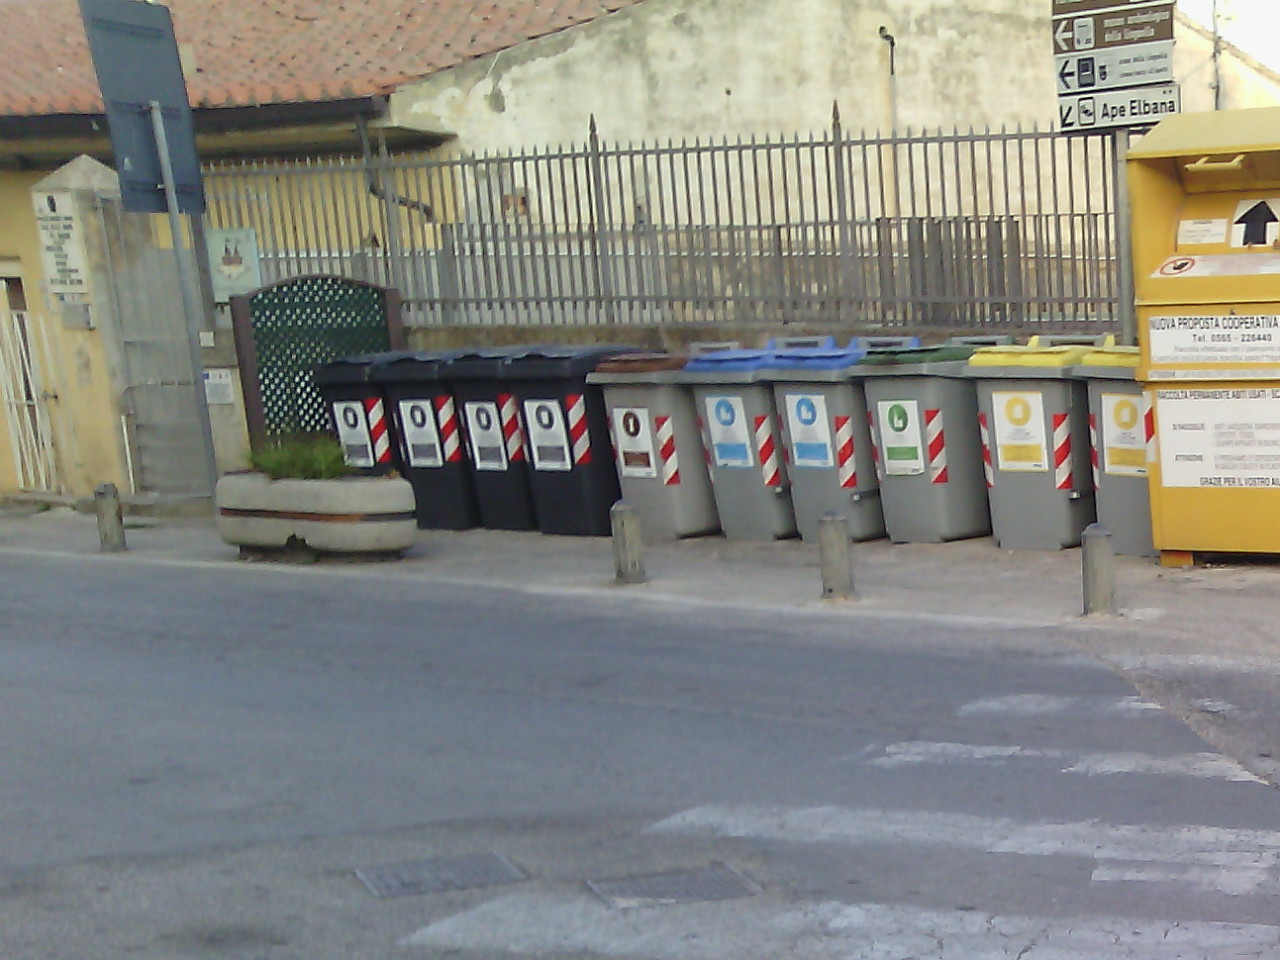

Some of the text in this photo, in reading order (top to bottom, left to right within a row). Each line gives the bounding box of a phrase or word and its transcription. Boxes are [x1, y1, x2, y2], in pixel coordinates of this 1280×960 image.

[1101, 99, 1175, 121] Ape Elbana
[1150, 317, 1176, 330] NUOVA
[1178, 317, 1220, 330] PROPOSTA
[1222, 316, 1279, 329] COOPERATIVA
[1223, 477, 1236, 486] PER
